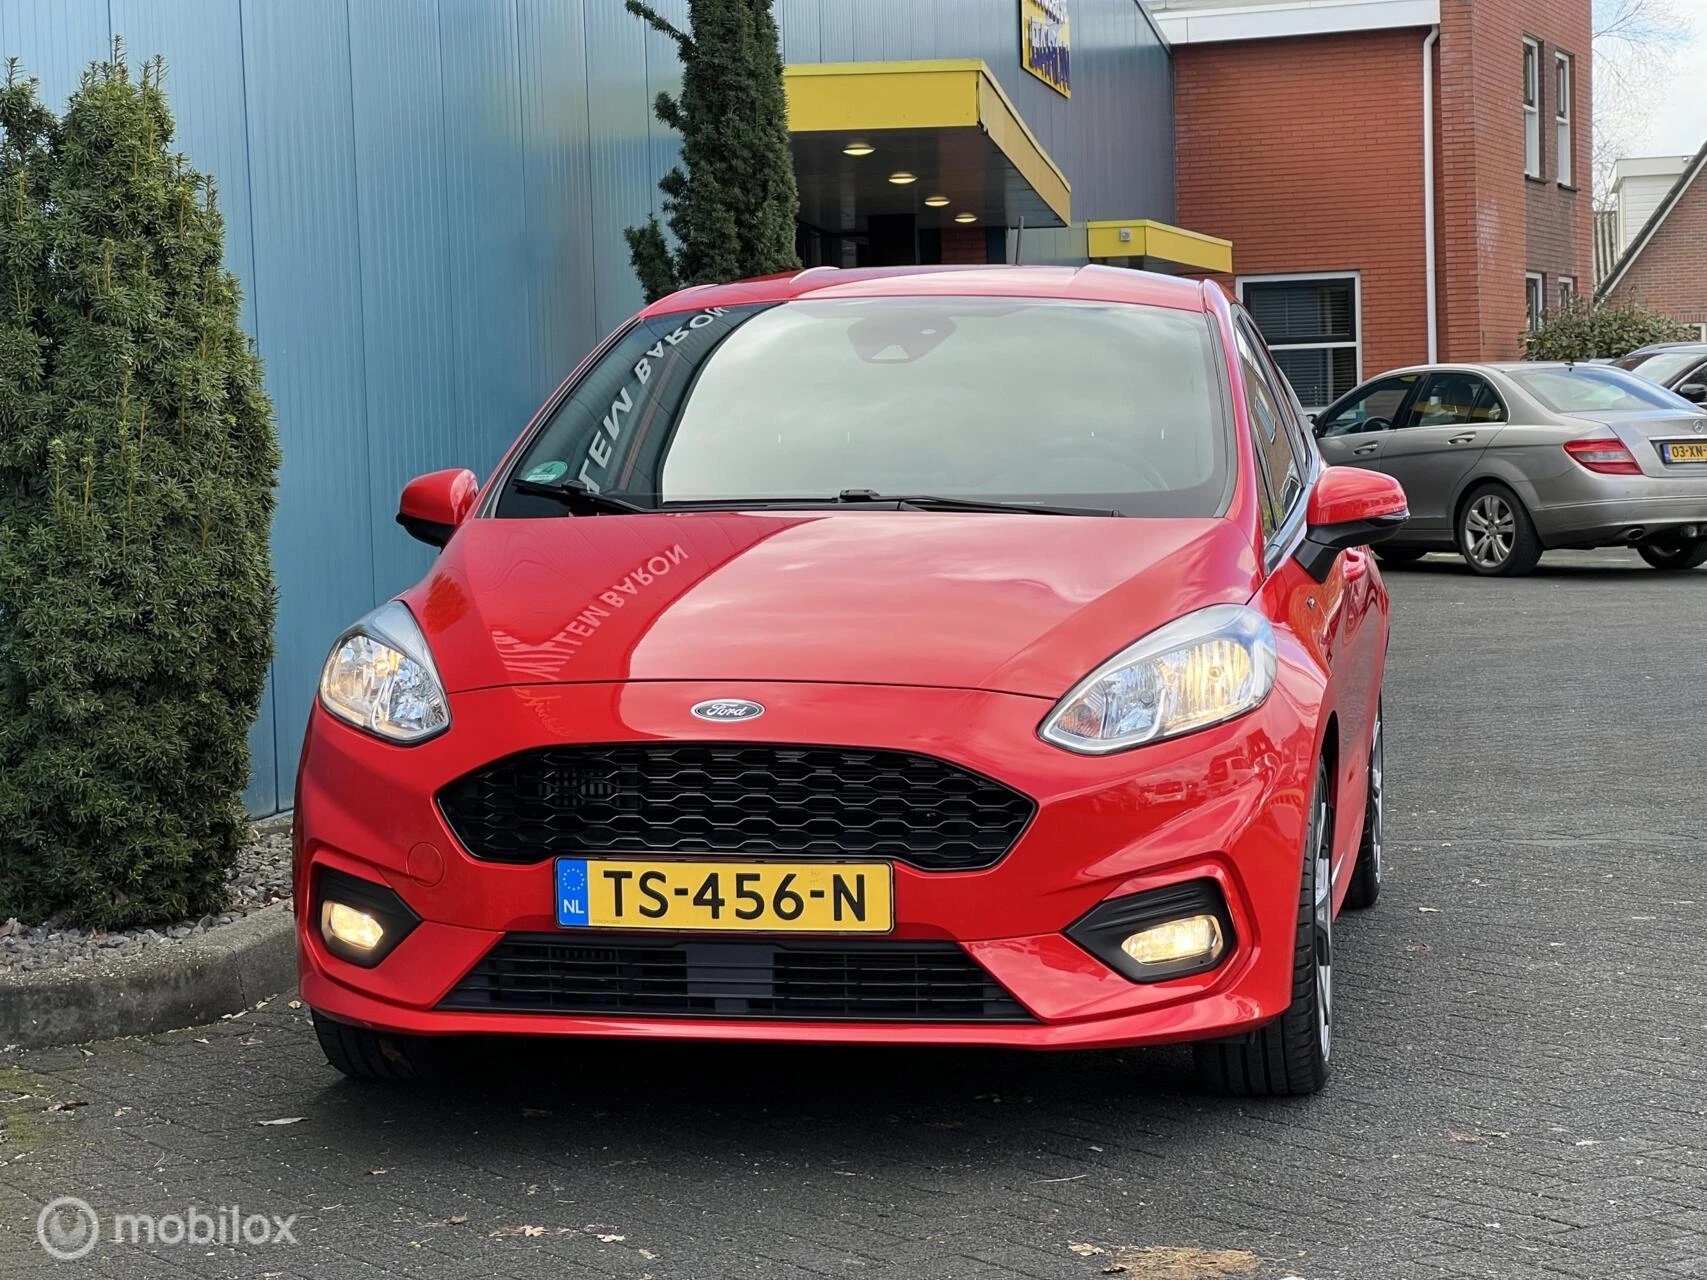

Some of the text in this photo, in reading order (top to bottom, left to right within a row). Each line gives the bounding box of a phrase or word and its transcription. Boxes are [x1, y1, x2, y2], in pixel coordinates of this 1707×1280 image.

[706, 703, 748, 716] Ford
[602, 869, 867, 922] TS-456-N
[563, 898, 585, 915] NL
